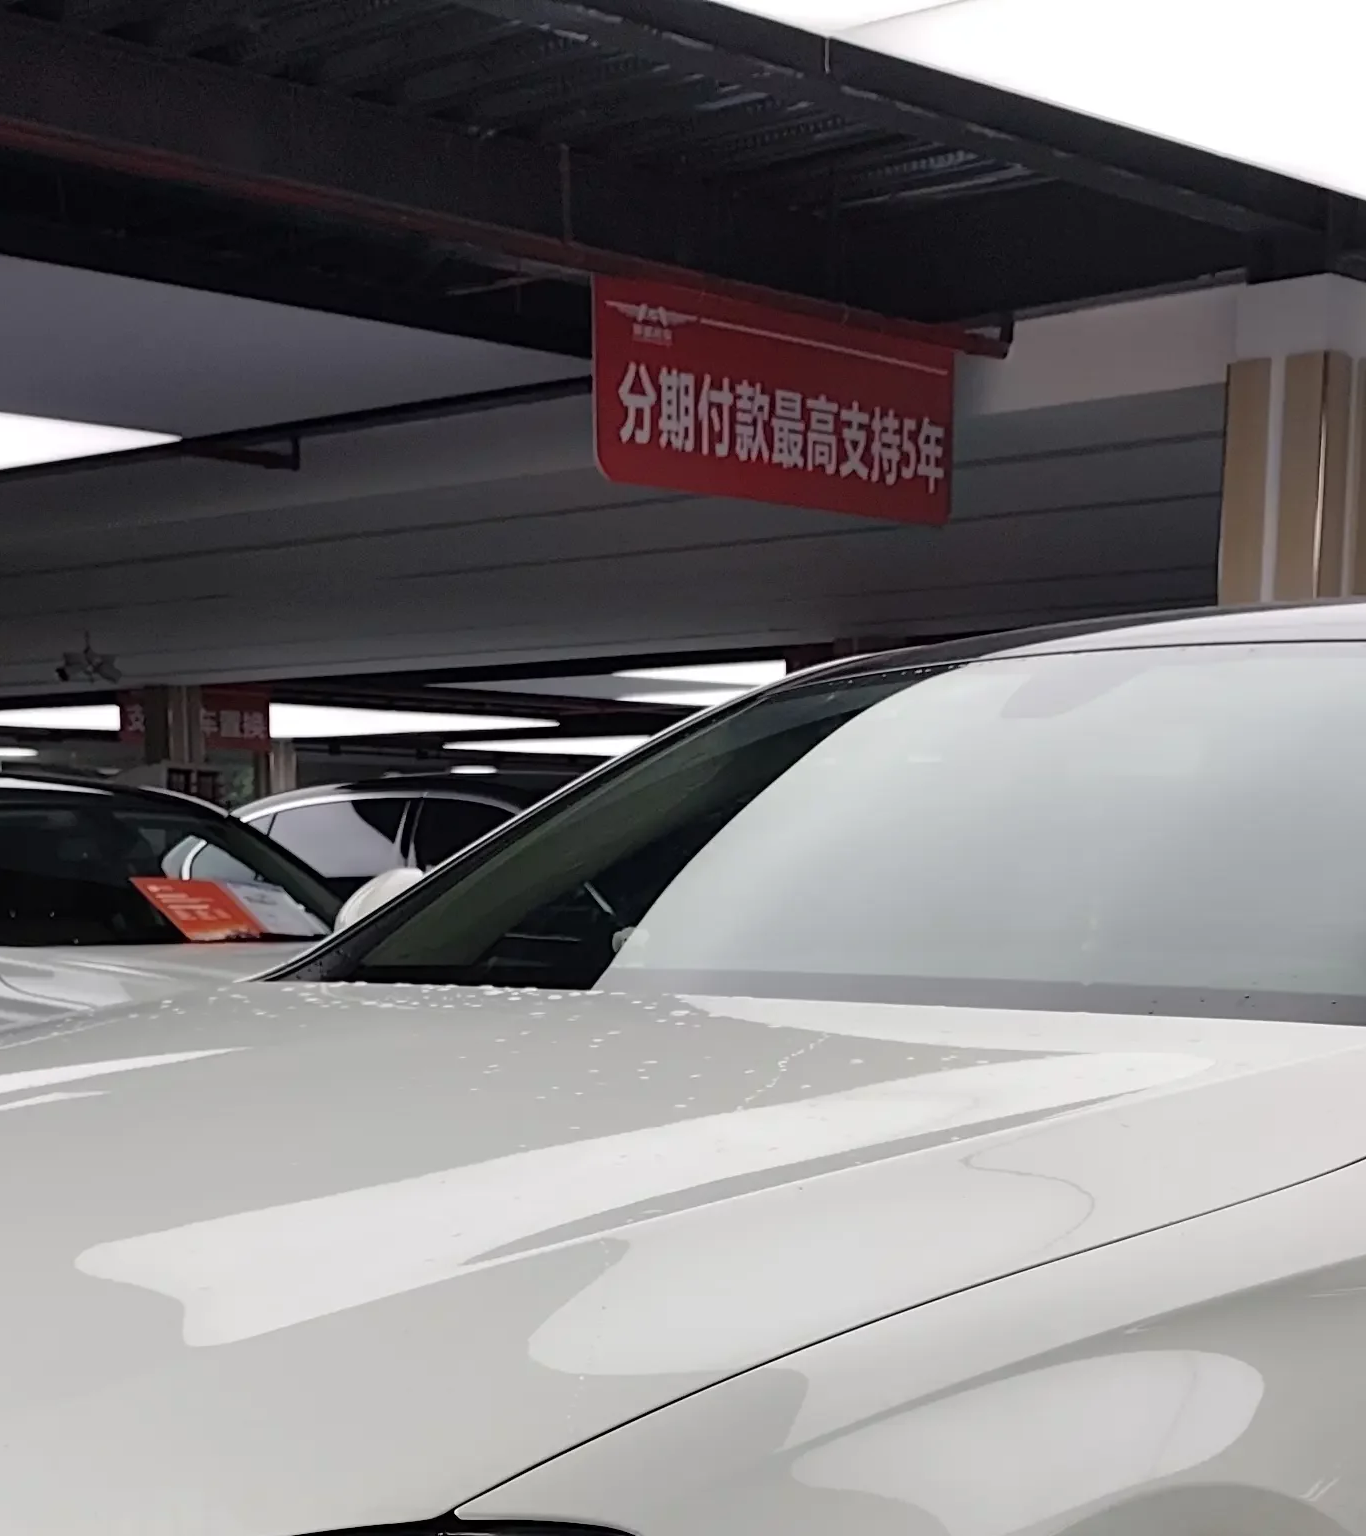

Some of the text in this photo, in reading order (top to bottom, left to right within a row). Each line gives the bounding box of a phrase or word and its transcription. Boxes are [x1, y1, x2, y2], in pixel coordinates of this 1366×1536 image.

[618, 362, 945, 493] 分期付款最高支持5年
